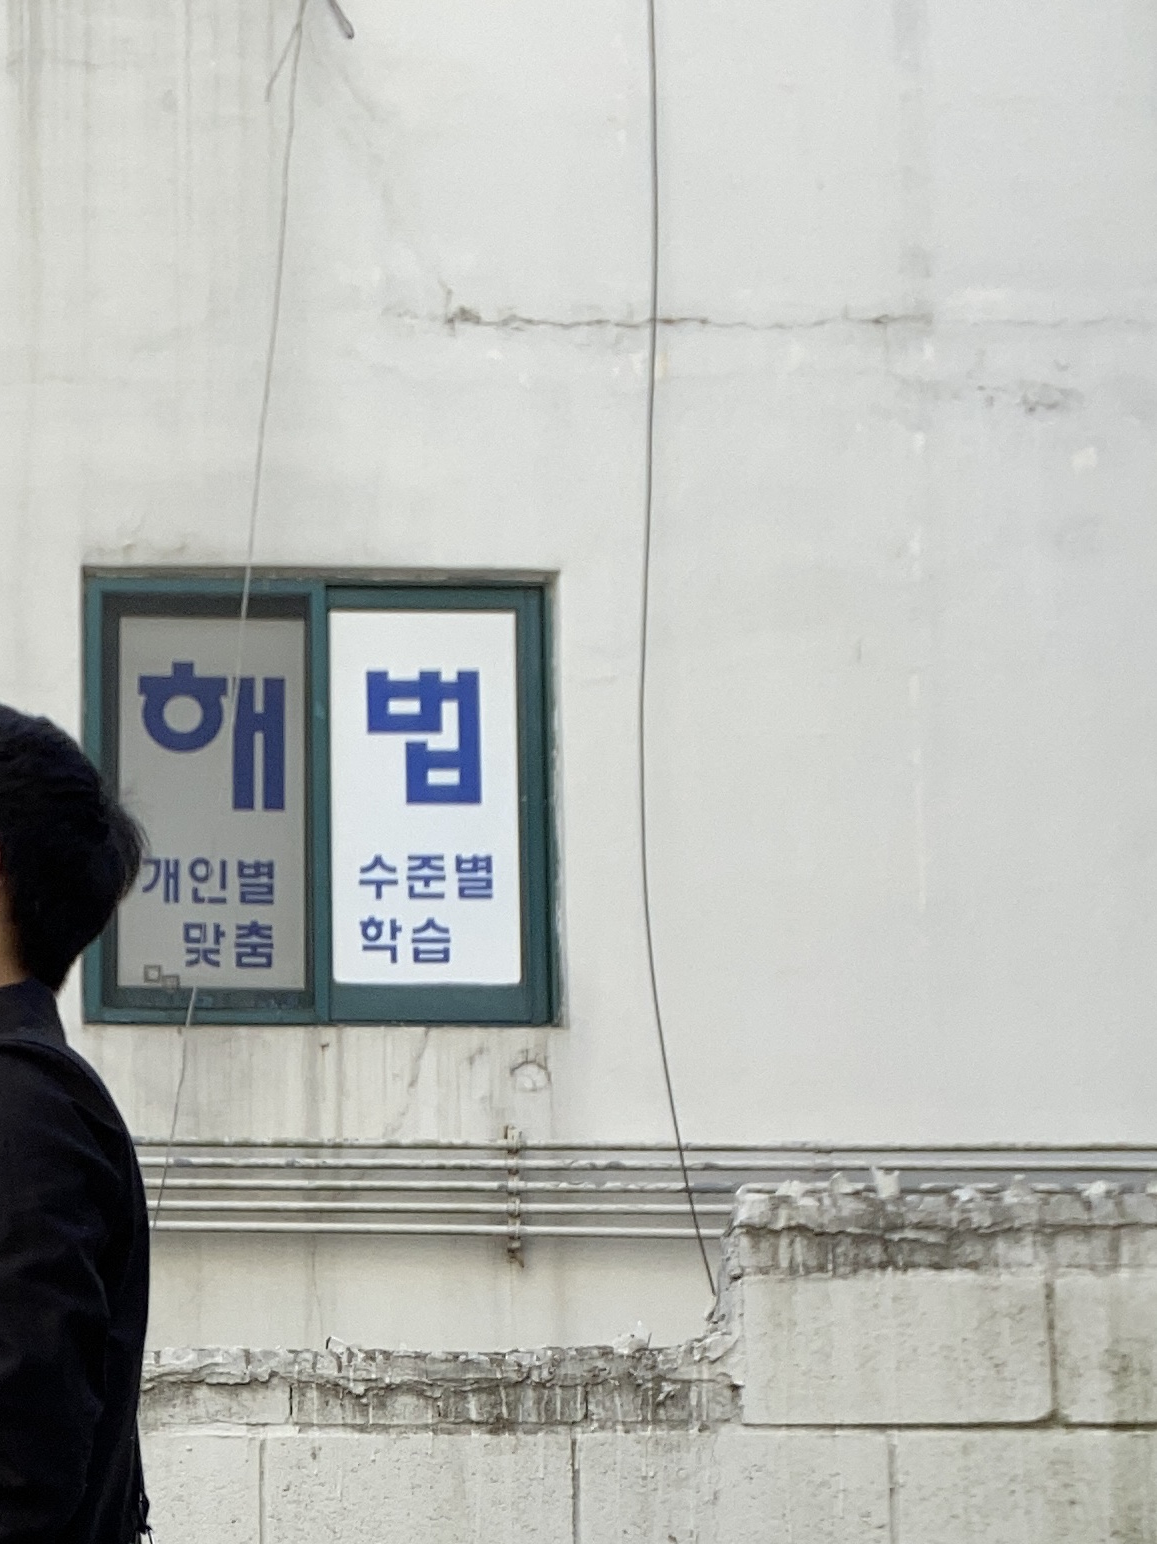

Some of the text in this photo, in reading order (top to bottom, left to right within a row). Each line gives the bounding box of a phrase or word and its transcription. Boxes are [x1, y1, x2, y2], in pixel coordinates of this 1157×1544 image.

[142, 857, 276, 905] 개인별
[358, 853, 494, 901] 수준별
[183, 920, 274, 968] 맞춤
[359, 916, 452, 964] 학습
